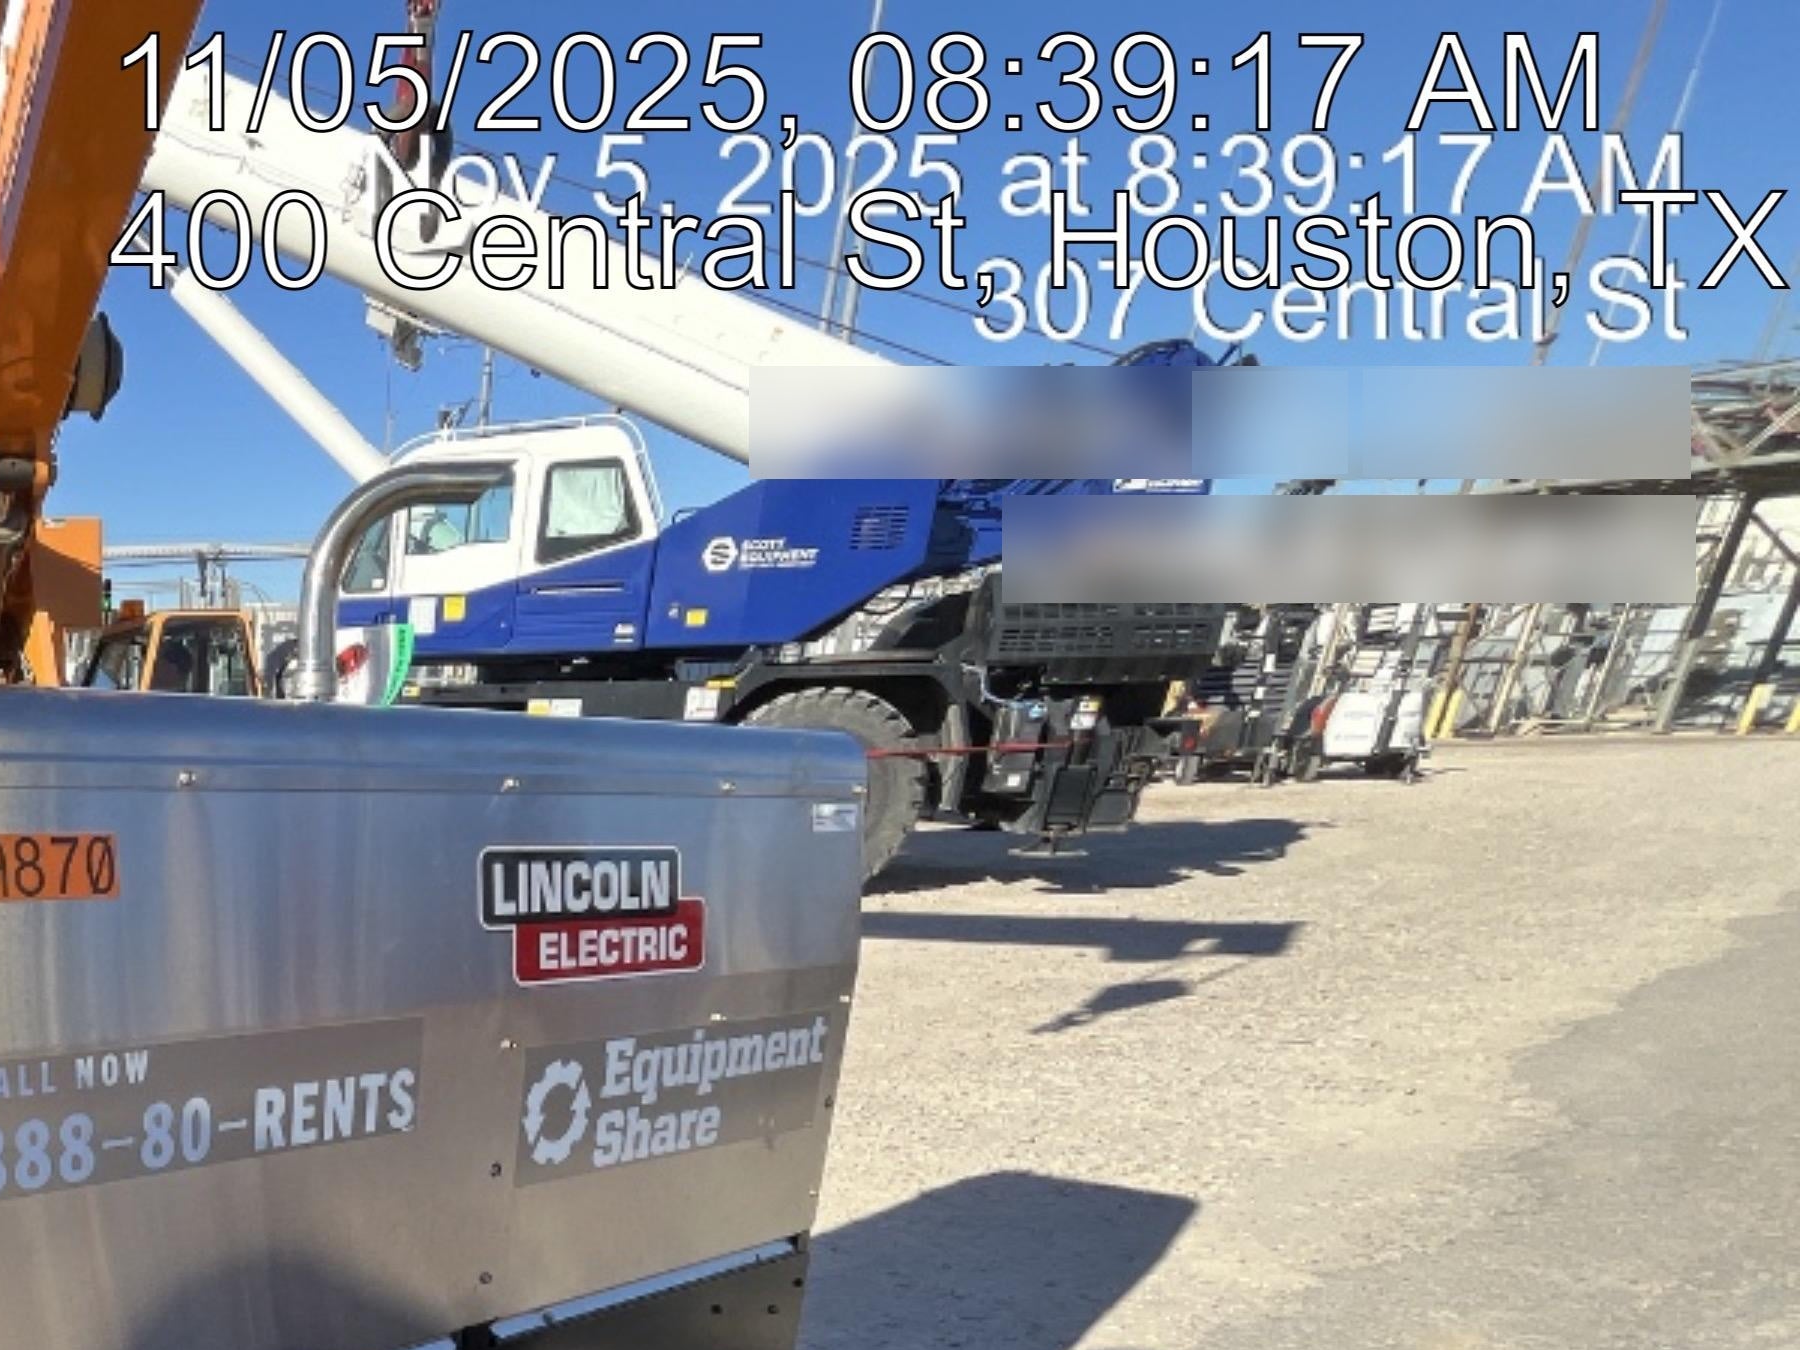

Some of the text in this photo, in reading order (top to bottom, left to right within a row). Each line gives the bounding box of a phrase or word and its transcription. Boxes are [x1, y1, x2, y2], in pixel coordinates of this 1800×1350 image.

[492, 860, 670, 916] LINCOLN
[538, 923, 689, 971] ELECTRIC
[75, 1050, 149, 1089] NOW
[601, 1015, 830, 1105] Equipment
[593, 1105, 722, 1168] Share
